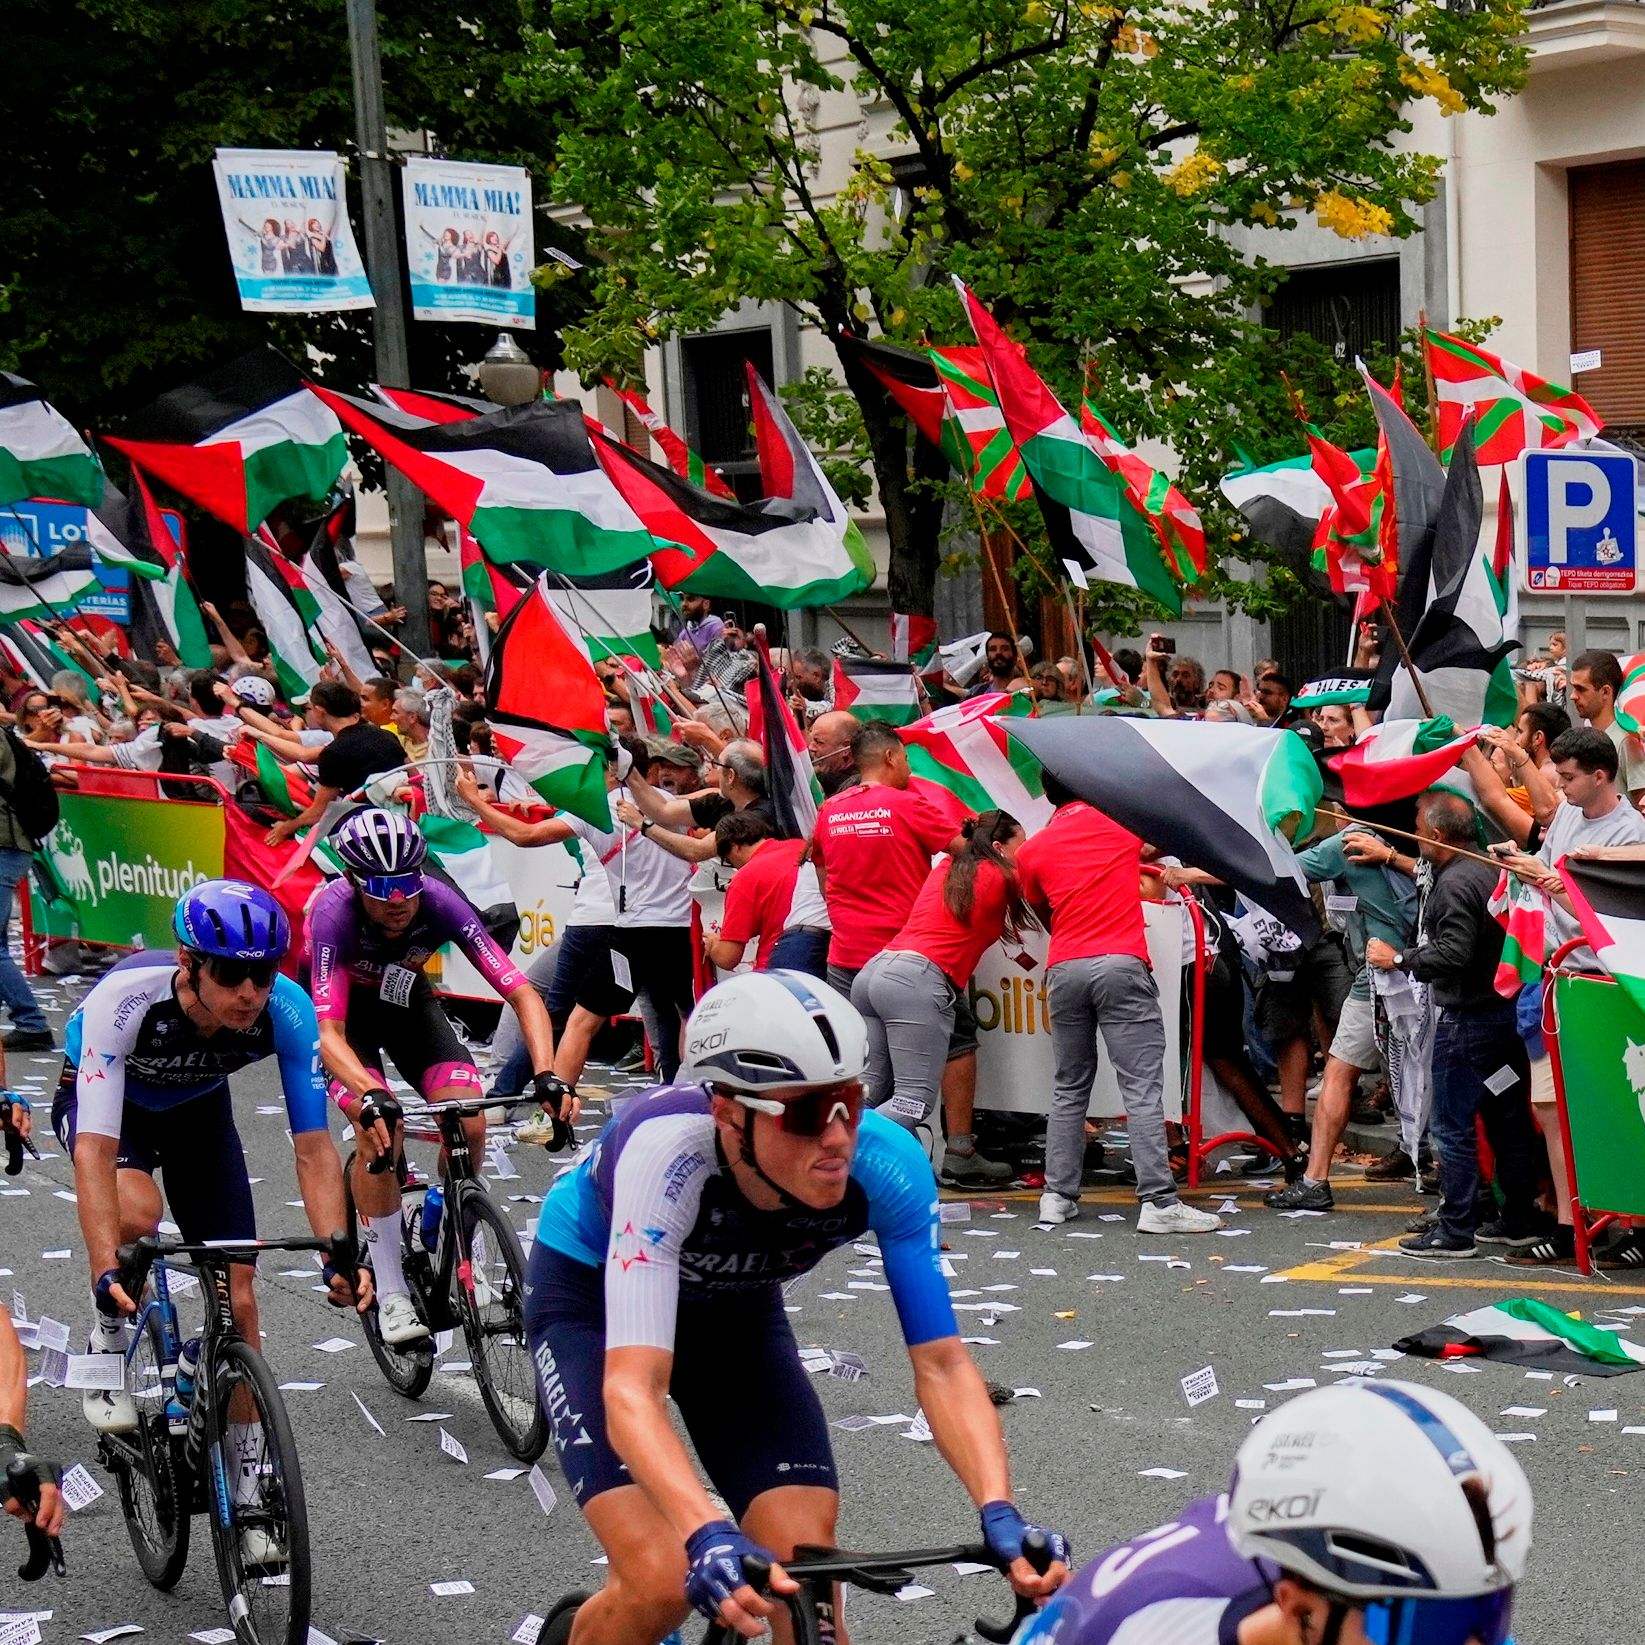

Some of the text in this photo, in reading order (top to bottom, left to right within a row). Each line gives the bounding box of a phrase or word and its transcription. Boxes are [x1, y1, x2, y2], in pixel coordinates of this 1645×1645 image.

[227, 175, 297, 199] MAMMA
[414, 183, 521, 215] MAMMA MIA!
[1547, 460, 1612, 564] P
[828, 807, 891, 824] ORGANIZACIÓN
[321, 946, 331, 982] CORTIZO
[474, 936, 501, 970] CORTIZO
[383, 972, 396, 996] ISRAEL
[113, 991, 150, 1032] FANTINI
[452, 1147, 469, 1157] BH
[665, 1151, 707, 1202] FANTINI
[214, 1269, 233, 1328] FACTOR
[535, 1341, 568, 1413] ISRAEL
